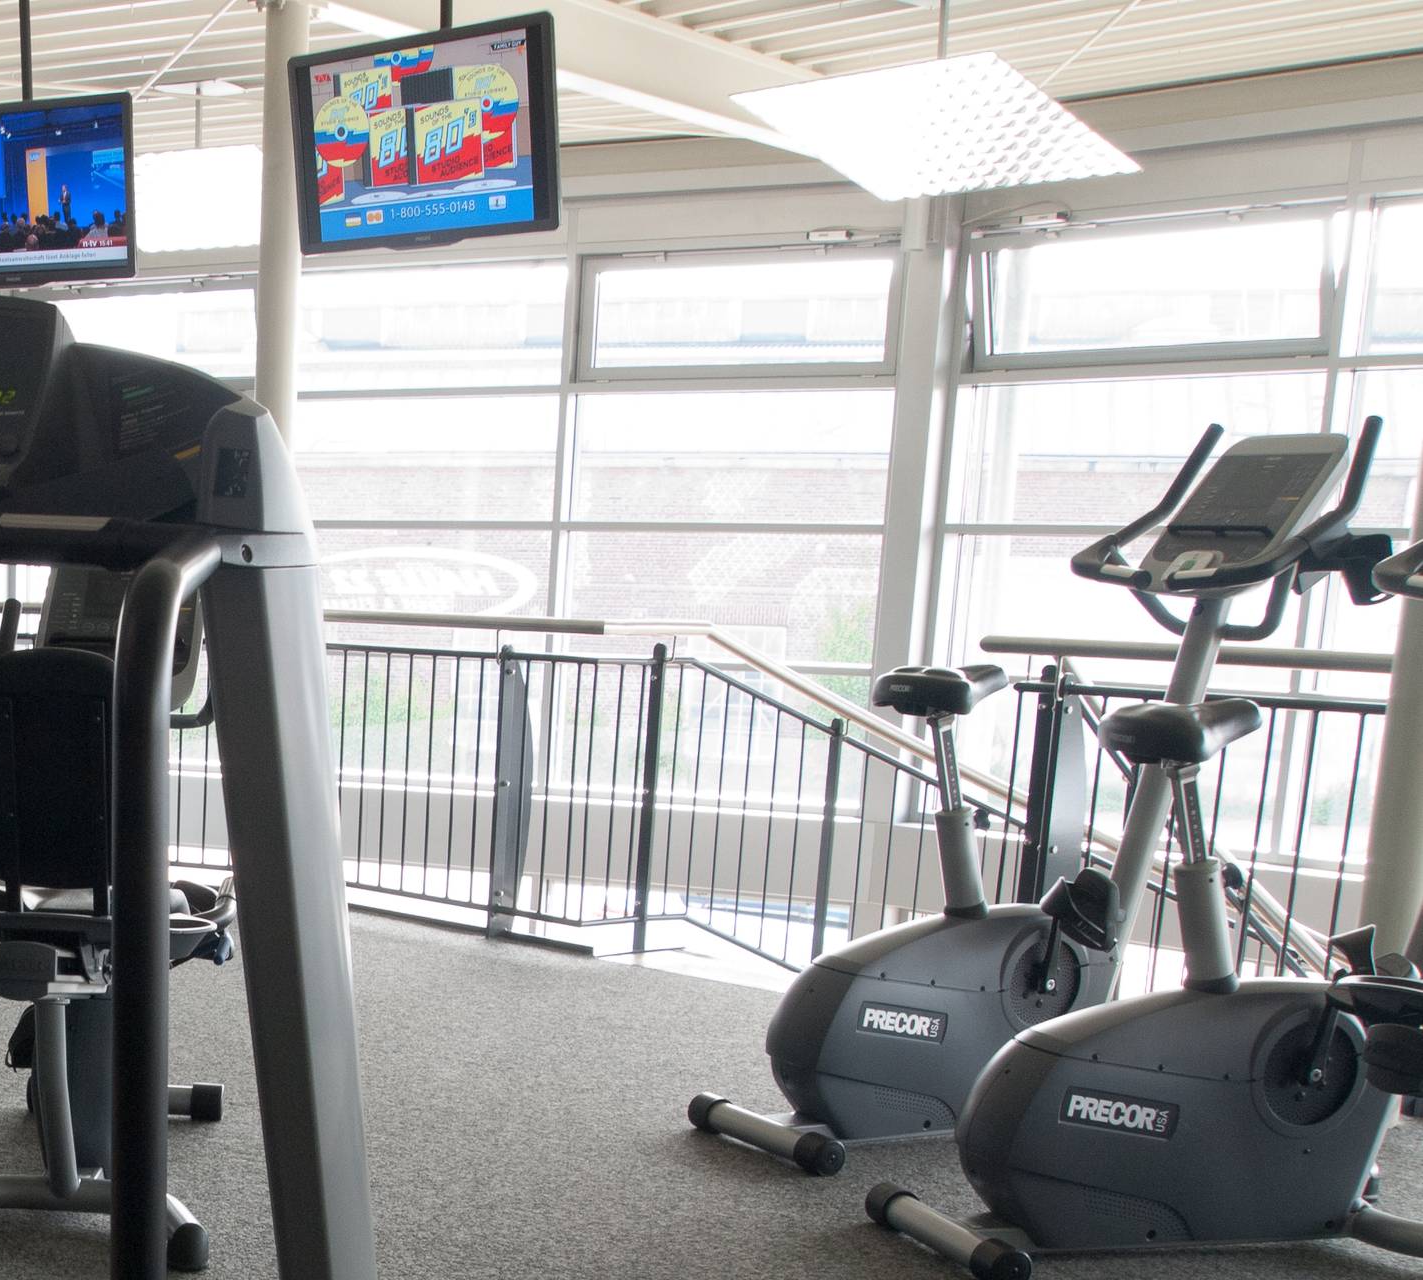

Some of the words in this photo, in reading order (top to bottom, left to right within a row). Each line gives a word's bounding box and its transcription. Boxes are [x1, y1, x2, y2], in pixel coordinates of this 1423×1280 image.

[373, 111, 401, 130] SOUNDS
[420, 105, 449, 125] SOUNDS
[432, 155, 460, 172] STUDIO
[440, 157, 478, 178] AUDIENCE
[390, 199, 475, 219] 1-800-555-0148
[862, 1008, 930, 1037] PRECOR
[930, 1018, 940, 1038] USA
[1067, 1094, 1156, 1131] PRECOR
[1155, 1110, 1169, 1132] USA
